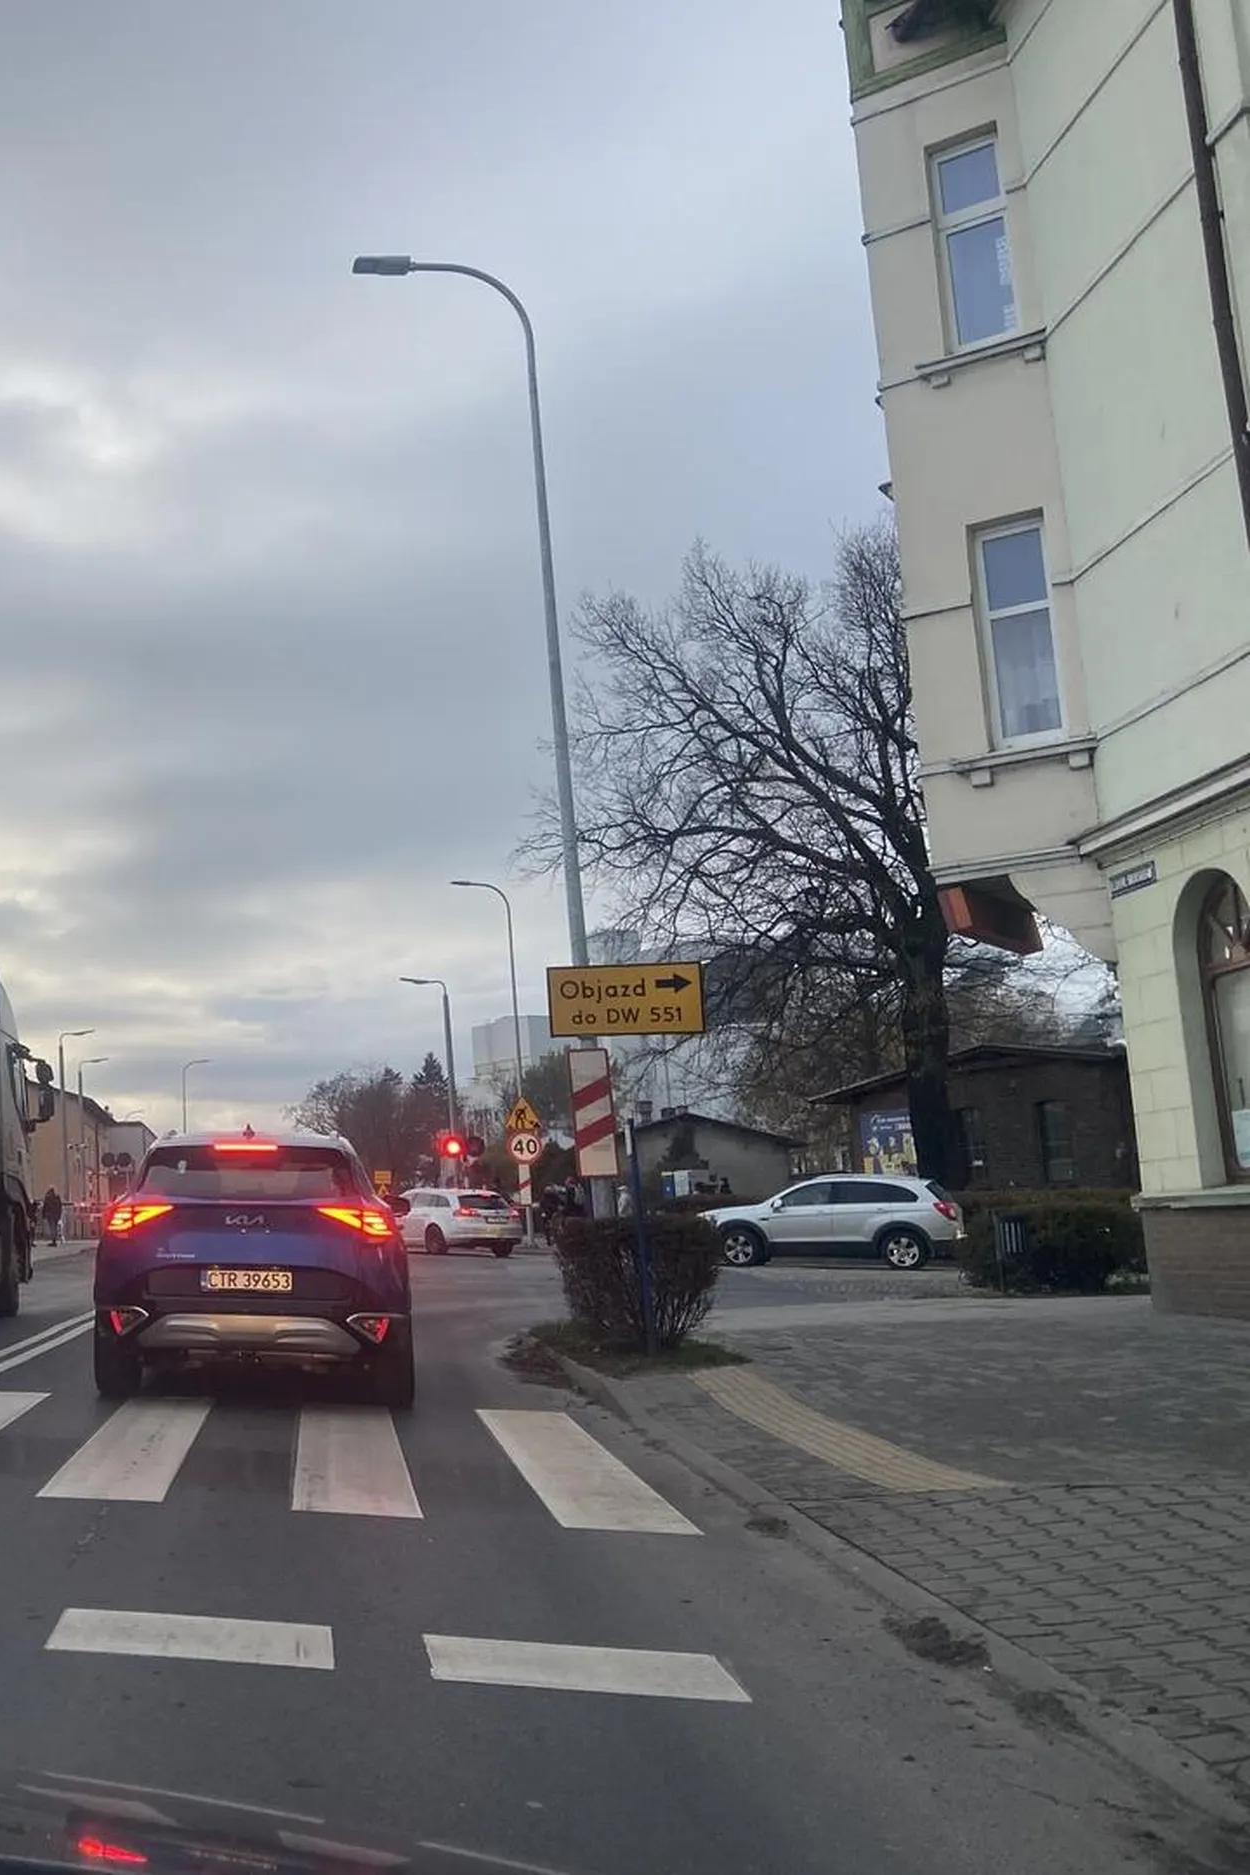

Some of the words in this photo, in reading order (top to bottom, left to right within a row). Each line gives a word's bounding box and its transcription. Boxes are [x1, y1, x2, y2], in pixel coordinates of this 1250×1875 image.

[560, 978, 646, 1003] Objazd
[572, 1010, 596, 1025] do
[606, 1007, 641, 1025] DW
[650, 1007, 682, 1023] 551
[513, 1139, 537, 1155] 40
[208, 1271, 238, 1288] CTR
[242, 1272, 291, 1289] 39653
